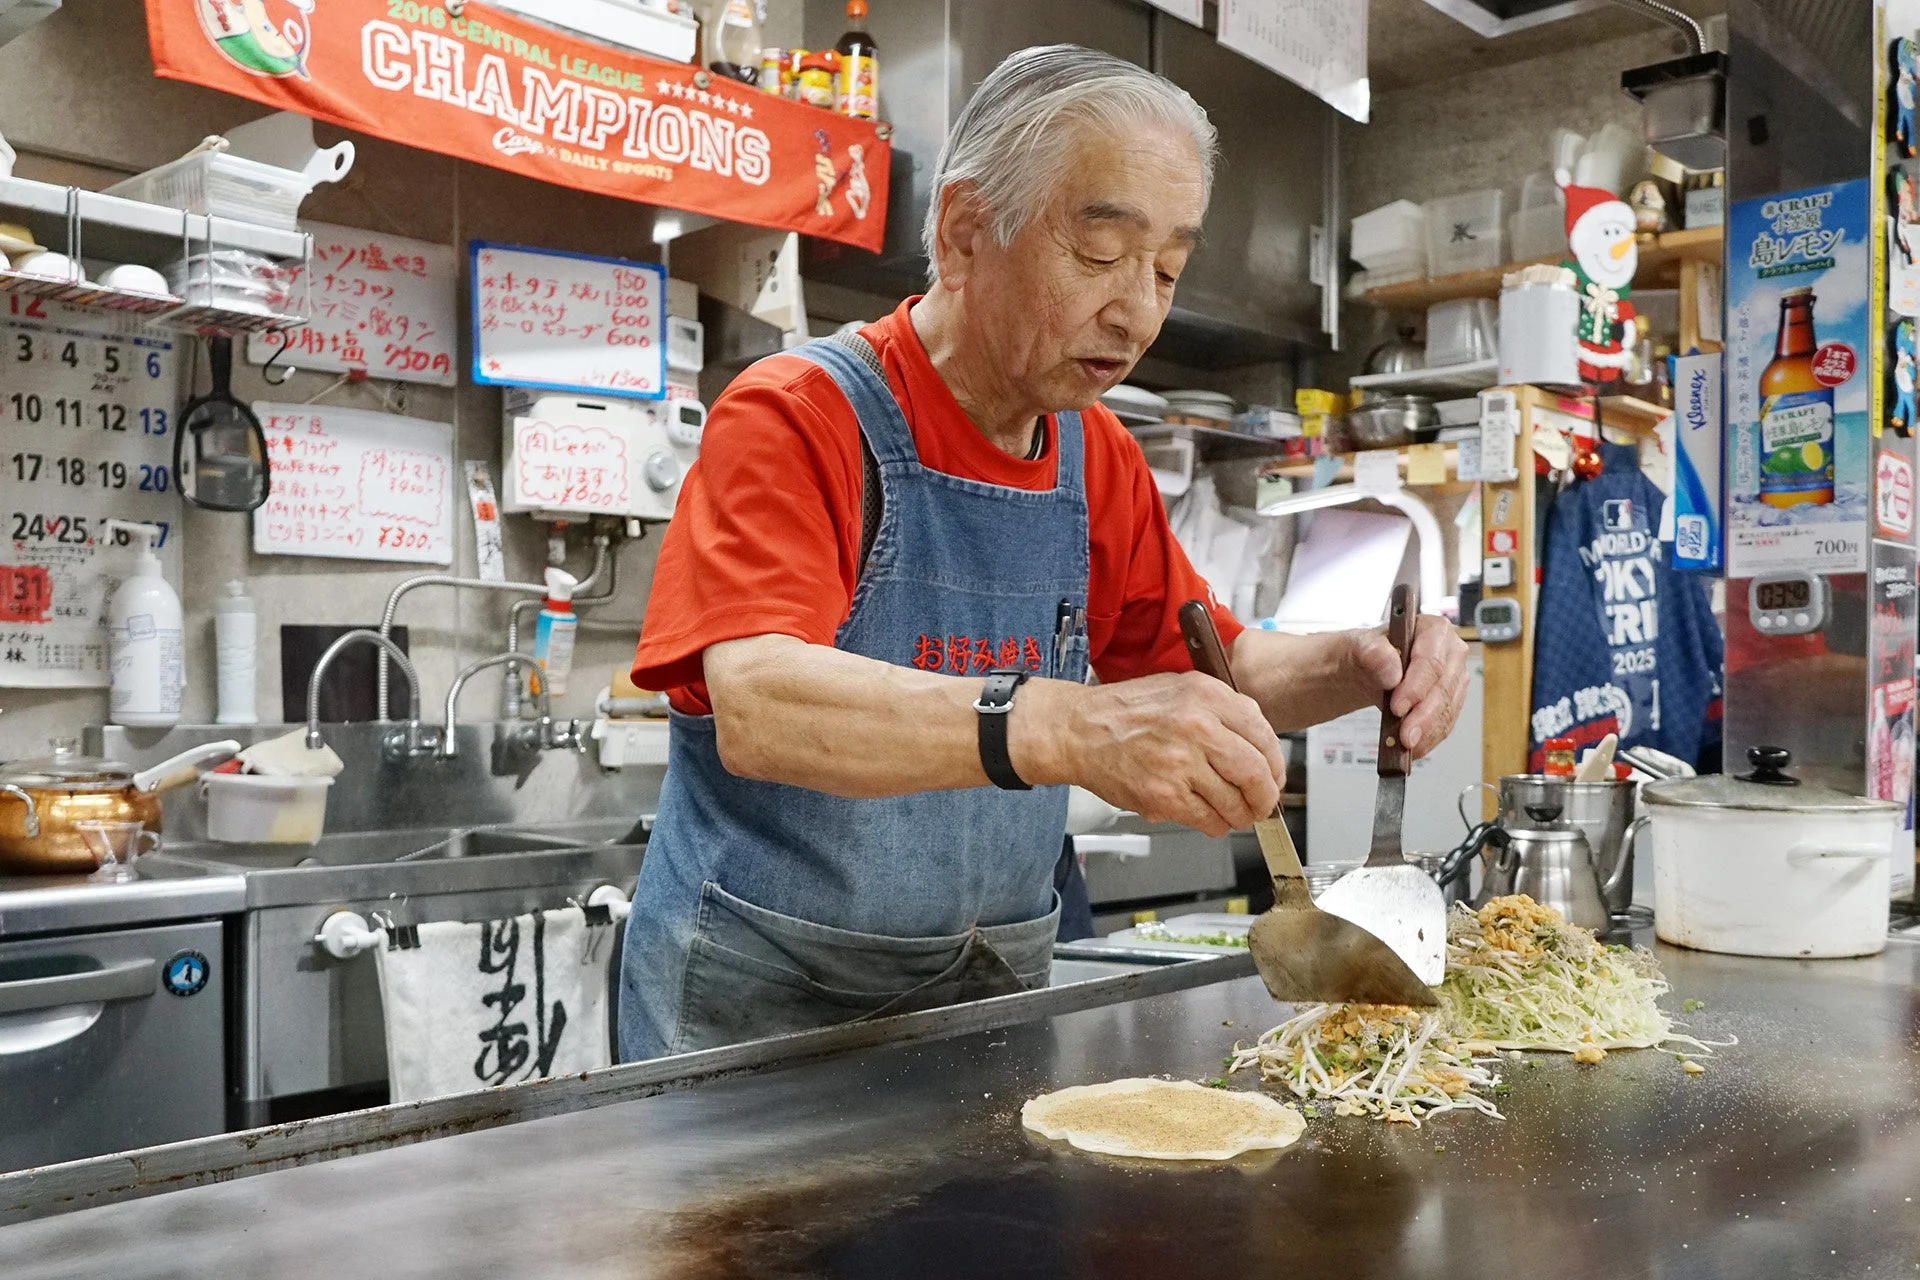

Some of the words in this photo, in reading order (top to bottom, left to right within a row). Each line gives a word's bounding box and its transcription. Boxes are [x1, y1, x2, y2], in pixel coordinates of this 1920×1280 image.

[387, 0, 446, 29] 2016
[451, 16, 557, 70] CENTRAL
[560, 53, 645, 93] LEAGUE
[361, 19, 771, 186] CHAMPIONS
[492, 126, 544, 156] Carp
[559, 149, 609, 172] DAILY
[612, 161, 674, 182] SPORTS
[1777, 192, 1831, 214] CRAFT
[1772, 211, 1822, 234] 小笠原
[1751, 228, 1844, 265] 島レモン
[604, 290, 649, 309] 1300
[611, 309, 650, 328] 600
[606, 327, 650, 348] 600
[17, 334, 33, 361] 3
[61, 341, 79, 368] 4
[105, 346, 120, 373] 5
[146, 352, 161, 378] 6
[11, 392, 42, 422] 10
[55, 398, 82, 427] 11
[98, 403, 126, 432] 12
[139, 407, 167, 435] 13
[1686, 368, 1707, 431] Kleenex
[12, 452, 43, 481] 17
[57, 457, 86, 486] 18
[98, 461, 127, 489] 19
[139, 464, 169, 492] 20
[12, 512, 46, 541] 24
[57, 515, 87, 544] 25
[1814, 539, 1858, 555] 700円
[14, 572, 43, 600] 31
[912, 633, 1042, 675] お好み焼き
[1613, 648, 1656, 675] 2025
